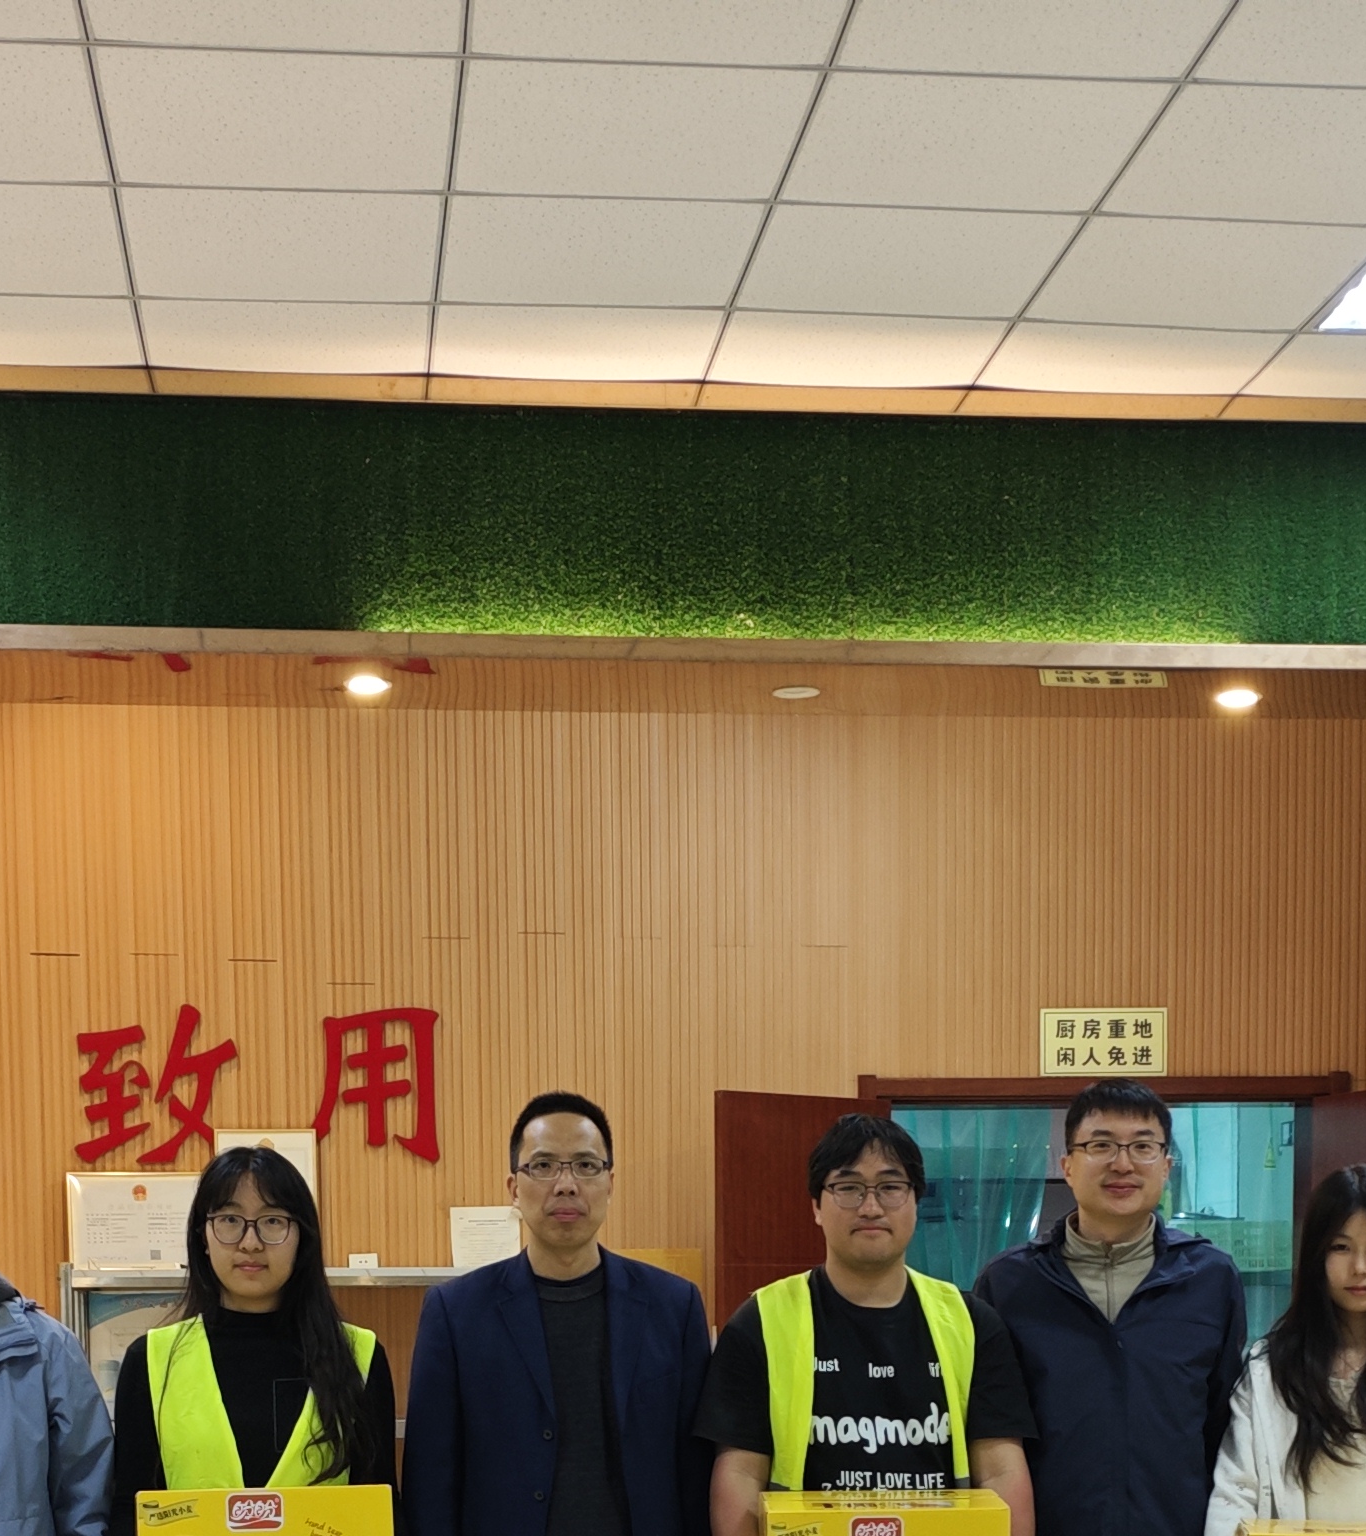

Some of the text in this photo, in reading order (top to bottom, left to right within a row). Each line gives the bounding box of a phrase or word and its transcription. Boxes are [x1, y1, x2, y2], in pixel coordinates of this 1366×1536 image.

[1056, 1018, 1153, 1040] 厨房重地
[1056, 1046, 1153, 1067] 闲人免进
[868, 1362, 895, 1378] love
[928, 1361, 943, 1378] lif
[835, 1470, 873, 1488] JUST
[876, 1471, 913, 1490] LOVE
[916, 1472, 946, 1490] LIFE
[230, 1499, 278, 1521] 盼盼
